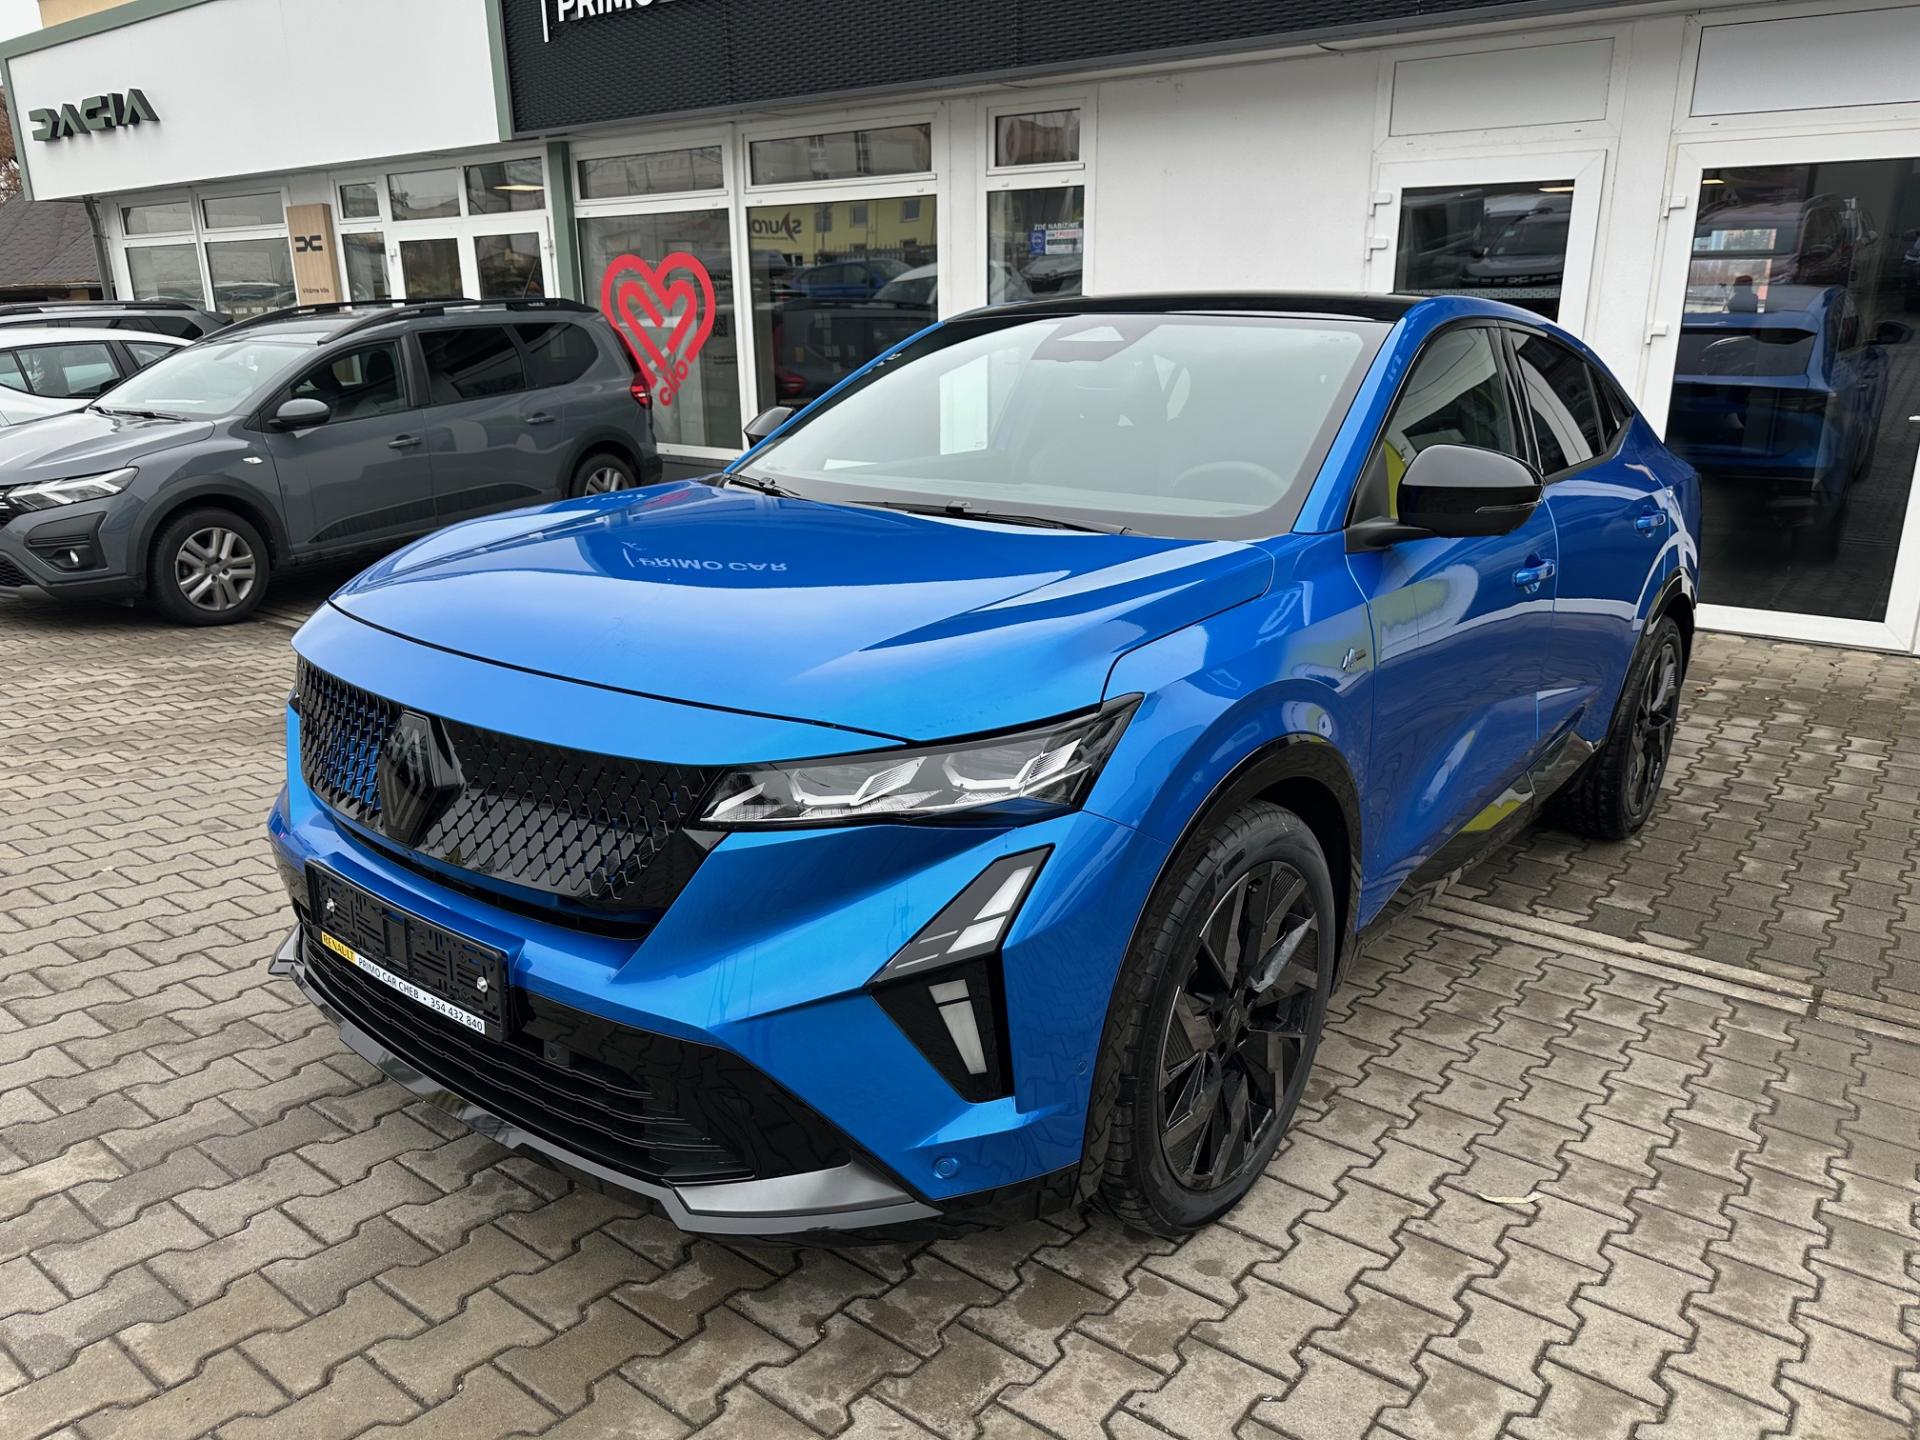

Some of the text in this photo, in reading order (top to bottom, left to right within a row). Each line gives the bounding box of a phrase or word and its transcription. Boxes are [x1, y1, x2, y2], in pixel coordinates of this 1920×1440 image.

[28, 88, 160, 141] DACIA
[659, 359, 689, 406] clio
[323, 934, 483, 1032] RENAULT PRIMO CAR CHEB 354 432 840
